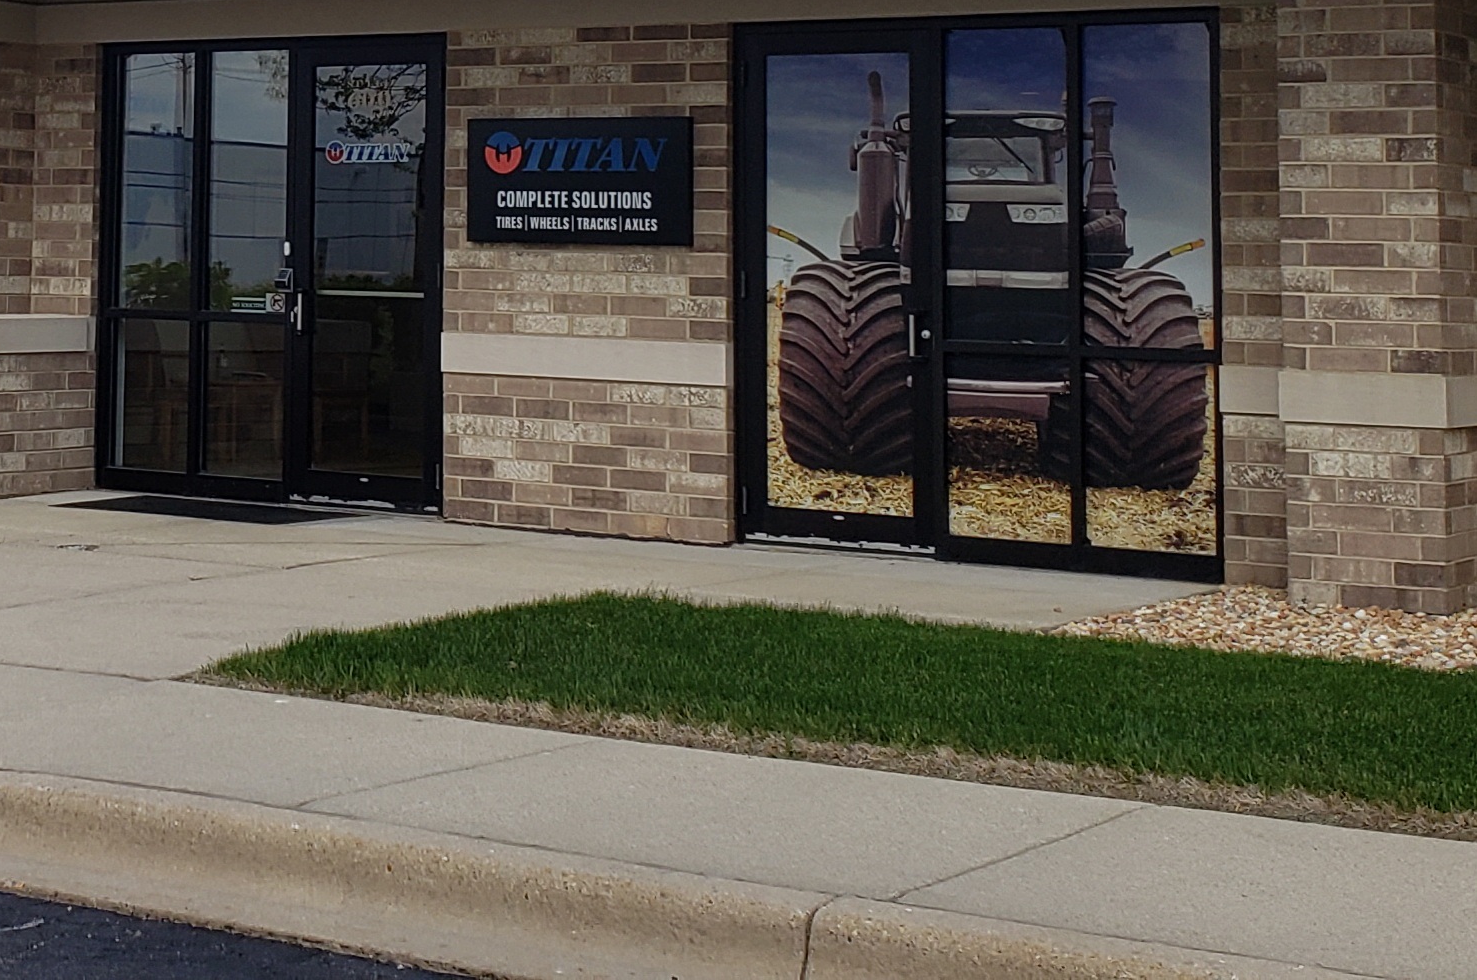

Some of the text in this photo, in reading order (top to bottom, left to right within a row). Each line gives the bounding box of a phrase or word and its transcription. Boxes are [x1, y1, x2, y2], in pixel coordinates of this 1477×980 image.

[343, 144, 410, 162] TITAN
[523, 138, 666, 172] TITAN
[497, 190, 652, 209] COMPLETE SOLUTIONS
[496, 216, 658, 231] TIRES WHEELS TRACKS AXLES
